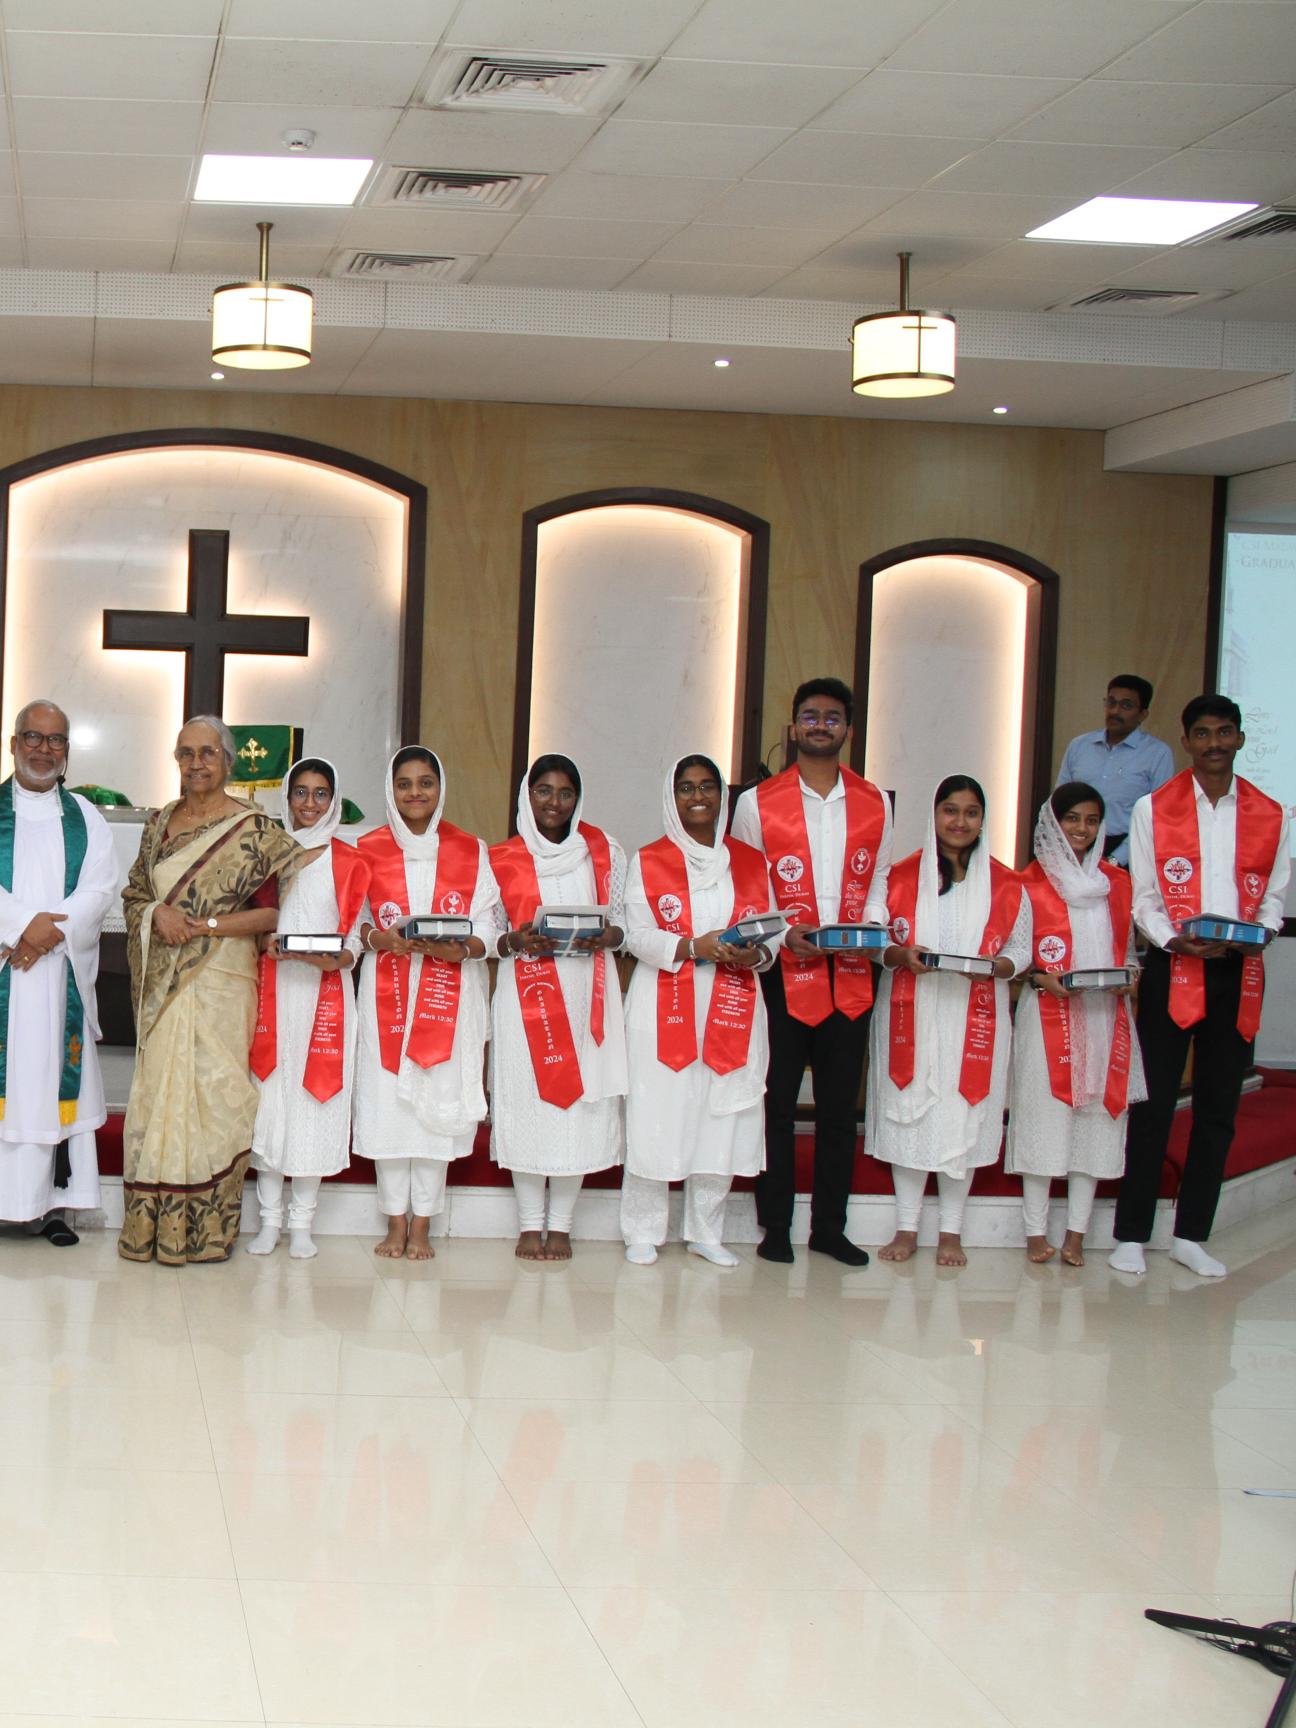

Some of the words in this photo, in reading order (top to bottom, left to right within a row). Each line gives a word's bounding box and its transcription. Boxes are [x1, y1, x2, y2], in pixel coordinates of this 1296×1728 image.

[784, 884, 801, 893] CSI
[1168, 886, 1187, 894] CSI
[666, 923, 680, 932] CSI
[524, 963, 542, 974] CSI
[1046, 964, 1063, 974] CSI
[794, 973, 814, 982] 2024
[419, 1012, 435, 1020] Mark
[667, 1016, 684, 1024] 2024
[544, 1055, 563, 1064] 2024
